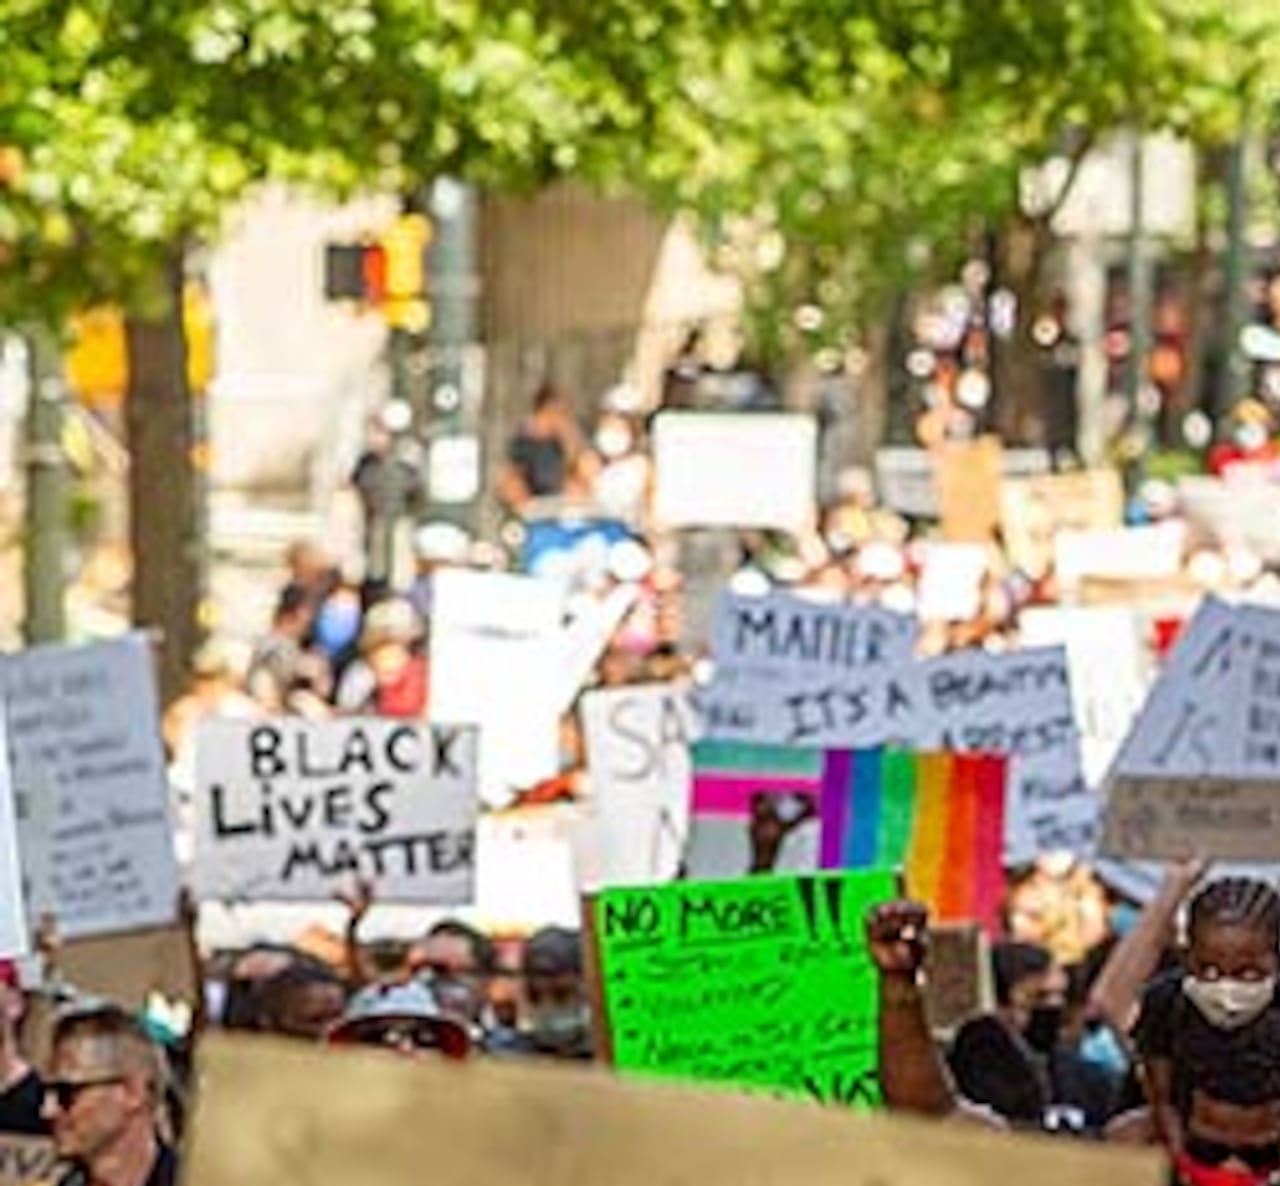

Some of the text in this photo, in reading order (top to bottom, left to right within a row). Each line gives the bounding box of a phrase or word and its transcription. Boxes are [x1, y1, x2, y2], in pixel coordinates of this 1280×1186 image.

[251, 727, 460, 777] BLACK
[280, 829, 475, 881] MATTER
[604, 897, 660, 940] NO
